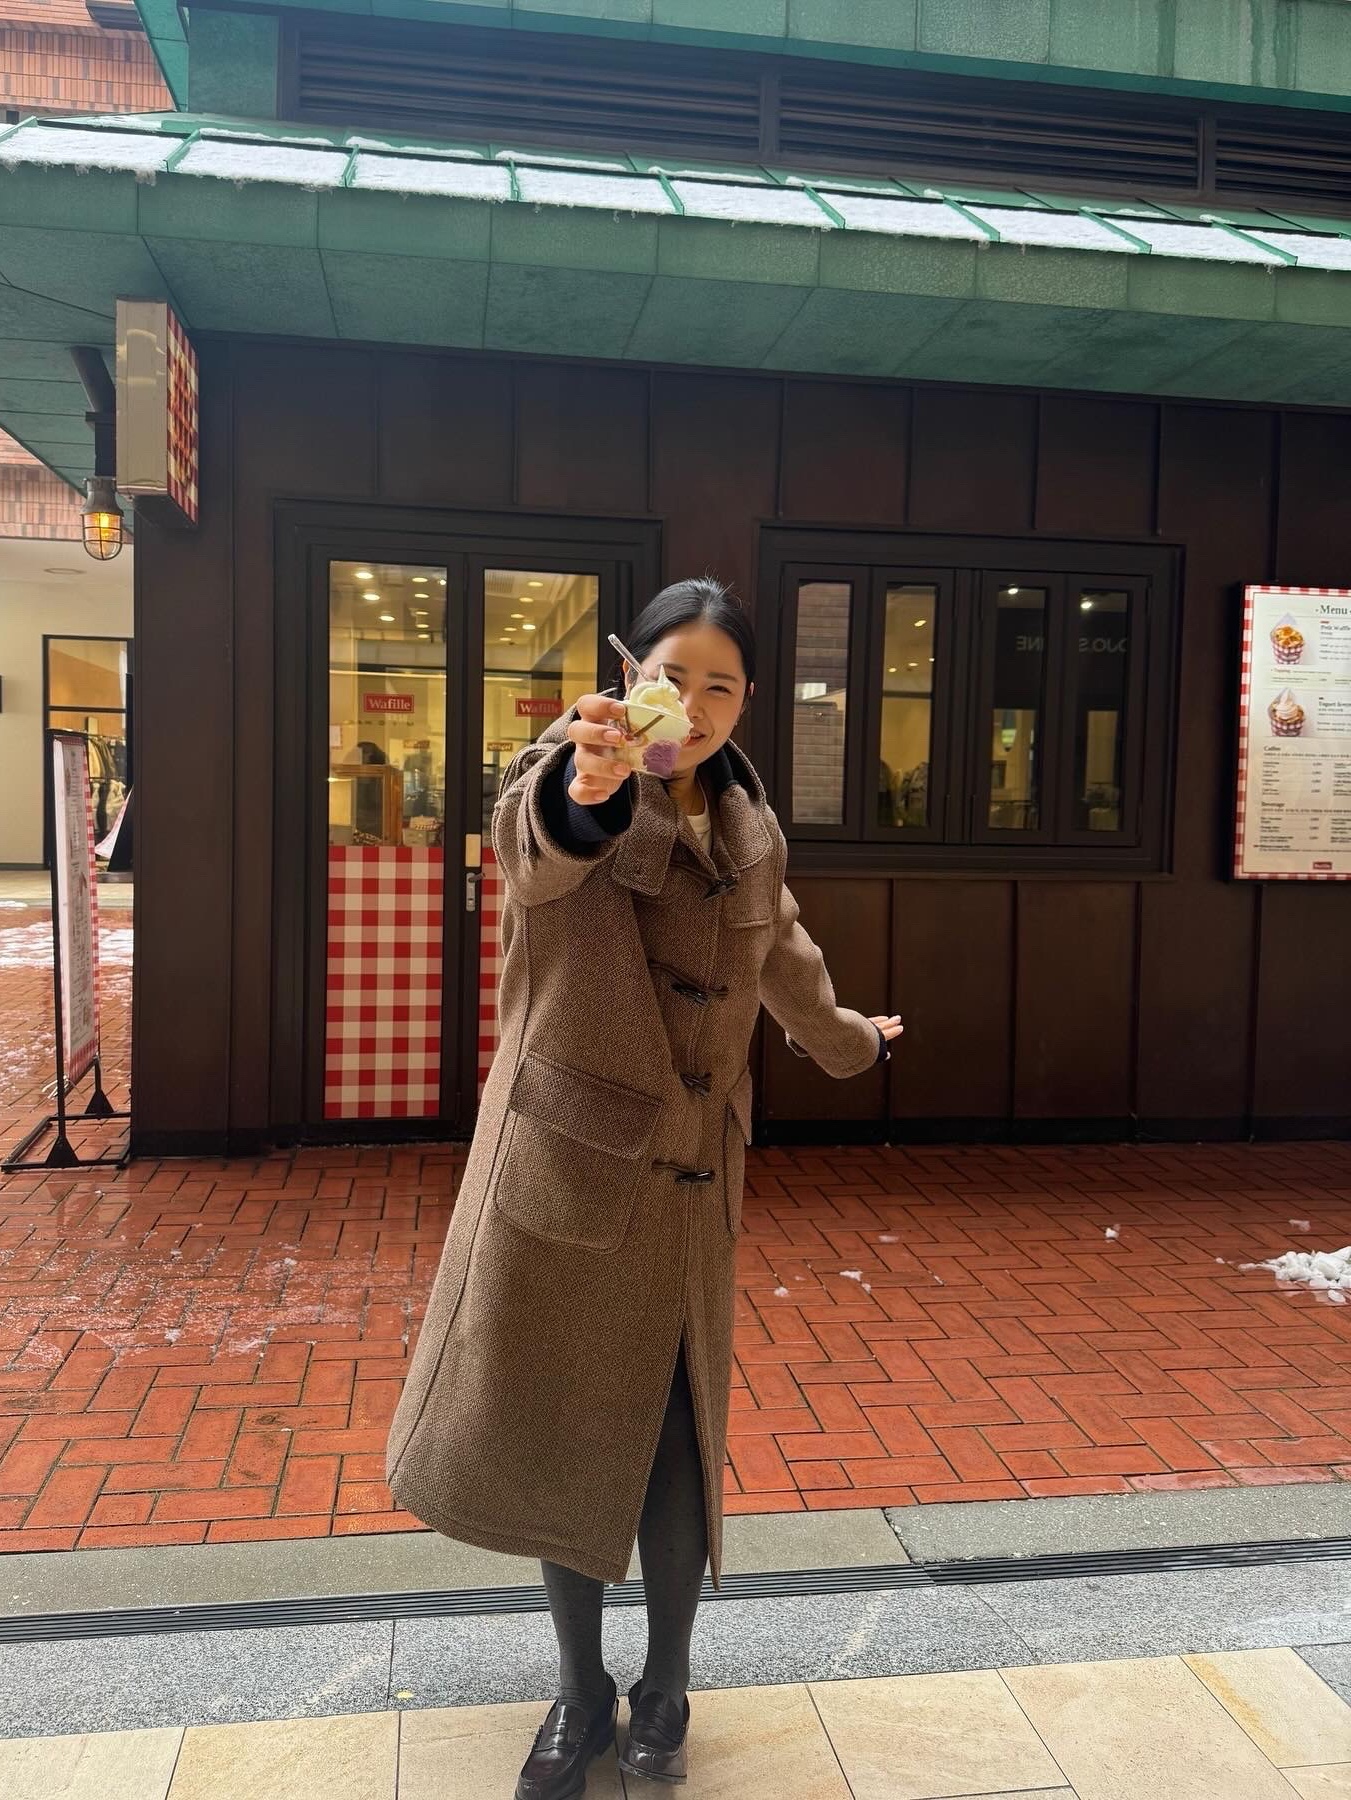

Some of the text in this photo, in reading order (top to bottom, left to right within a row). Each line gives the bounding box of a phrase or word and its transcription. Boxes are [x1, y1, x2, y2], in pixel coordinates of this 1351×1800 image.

[1320, 605, 1348, 615] Menu
[369, 698, 411, 710] Wafille
[519, 702, 561, 714] Wafille
